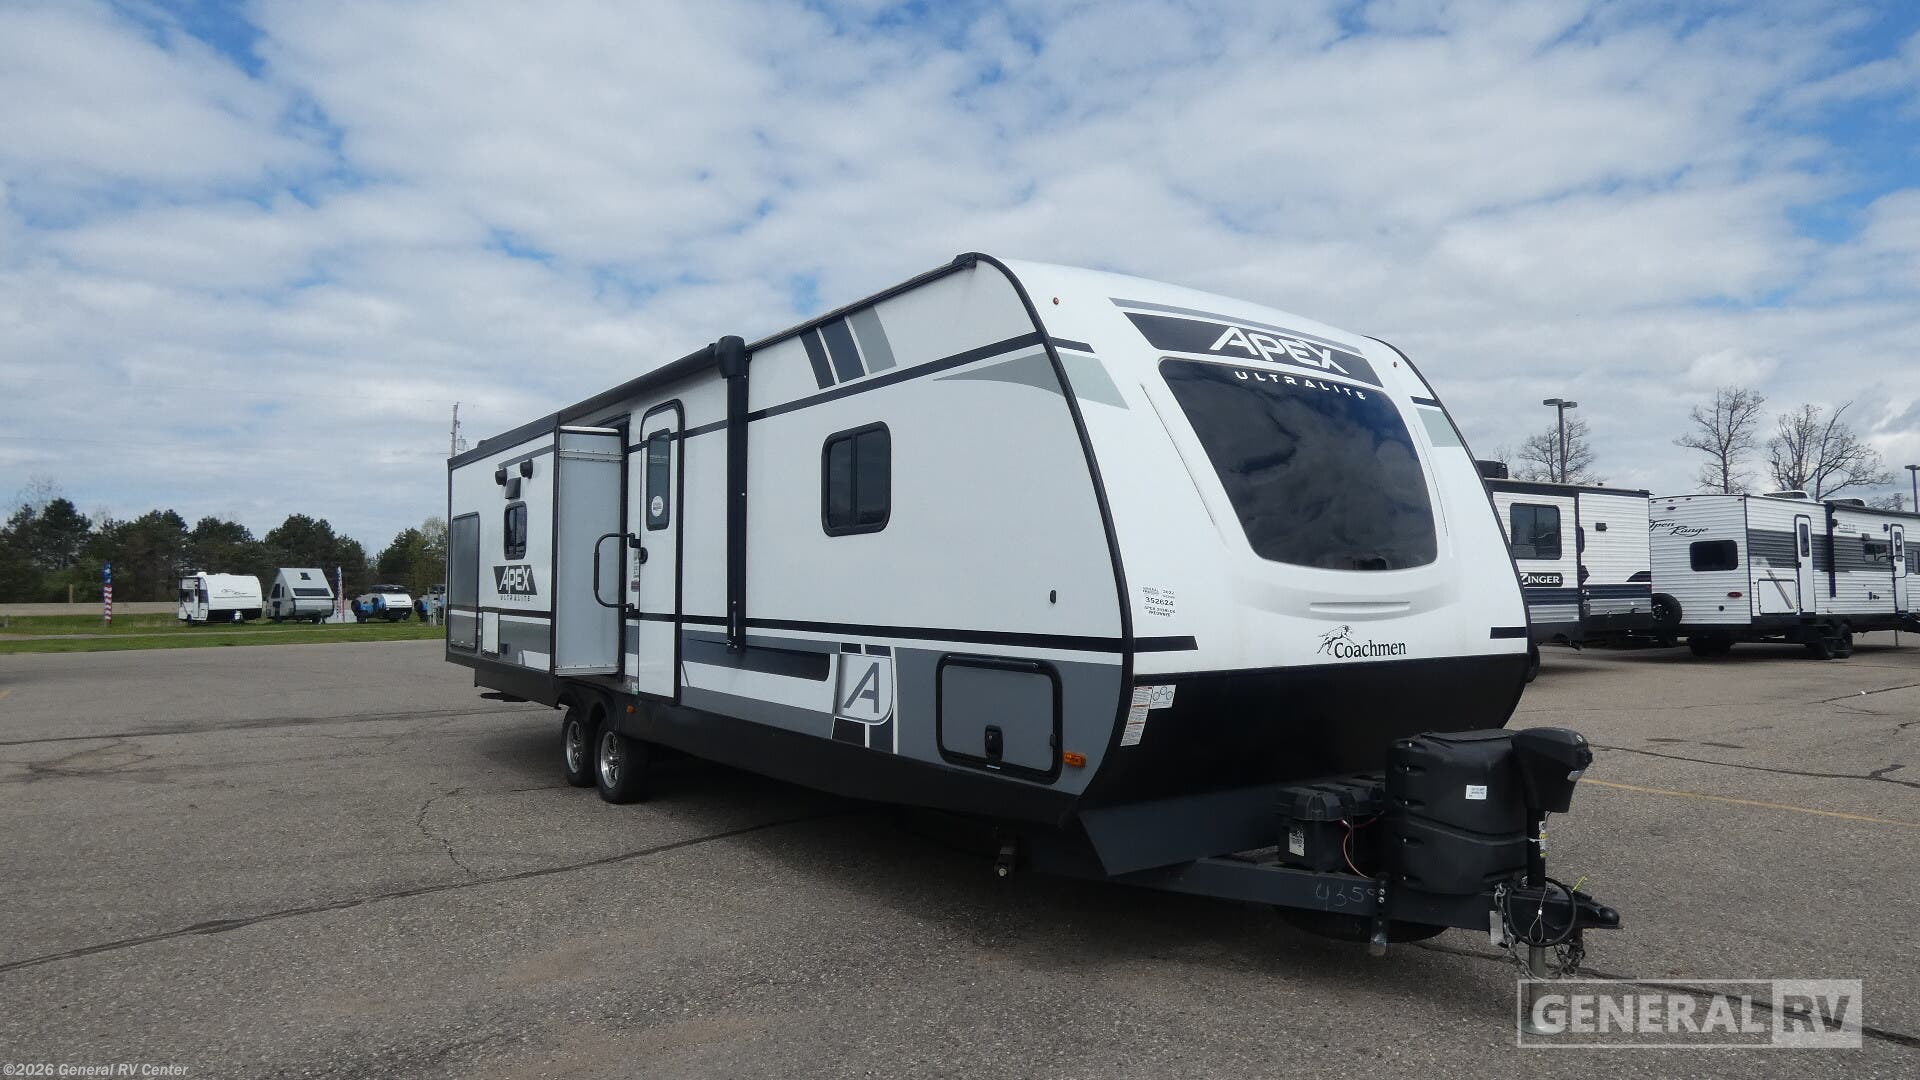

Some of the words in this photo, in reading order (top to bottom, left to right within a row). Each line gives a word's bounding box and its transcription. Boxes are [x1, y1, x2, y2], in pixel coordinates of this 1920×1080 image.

[1209, 326, 1350, 375] APEX
[1234, 370, 1366, 400] ULTRALITE
[1668, 525, 1709, 538] Range
[499, 565, 530, 593] APEX
[1520, 572, 1560, 585] ZINGER
[1334, 639, 1407, 658] Coachmen
[843, 662, 880, 714] A
